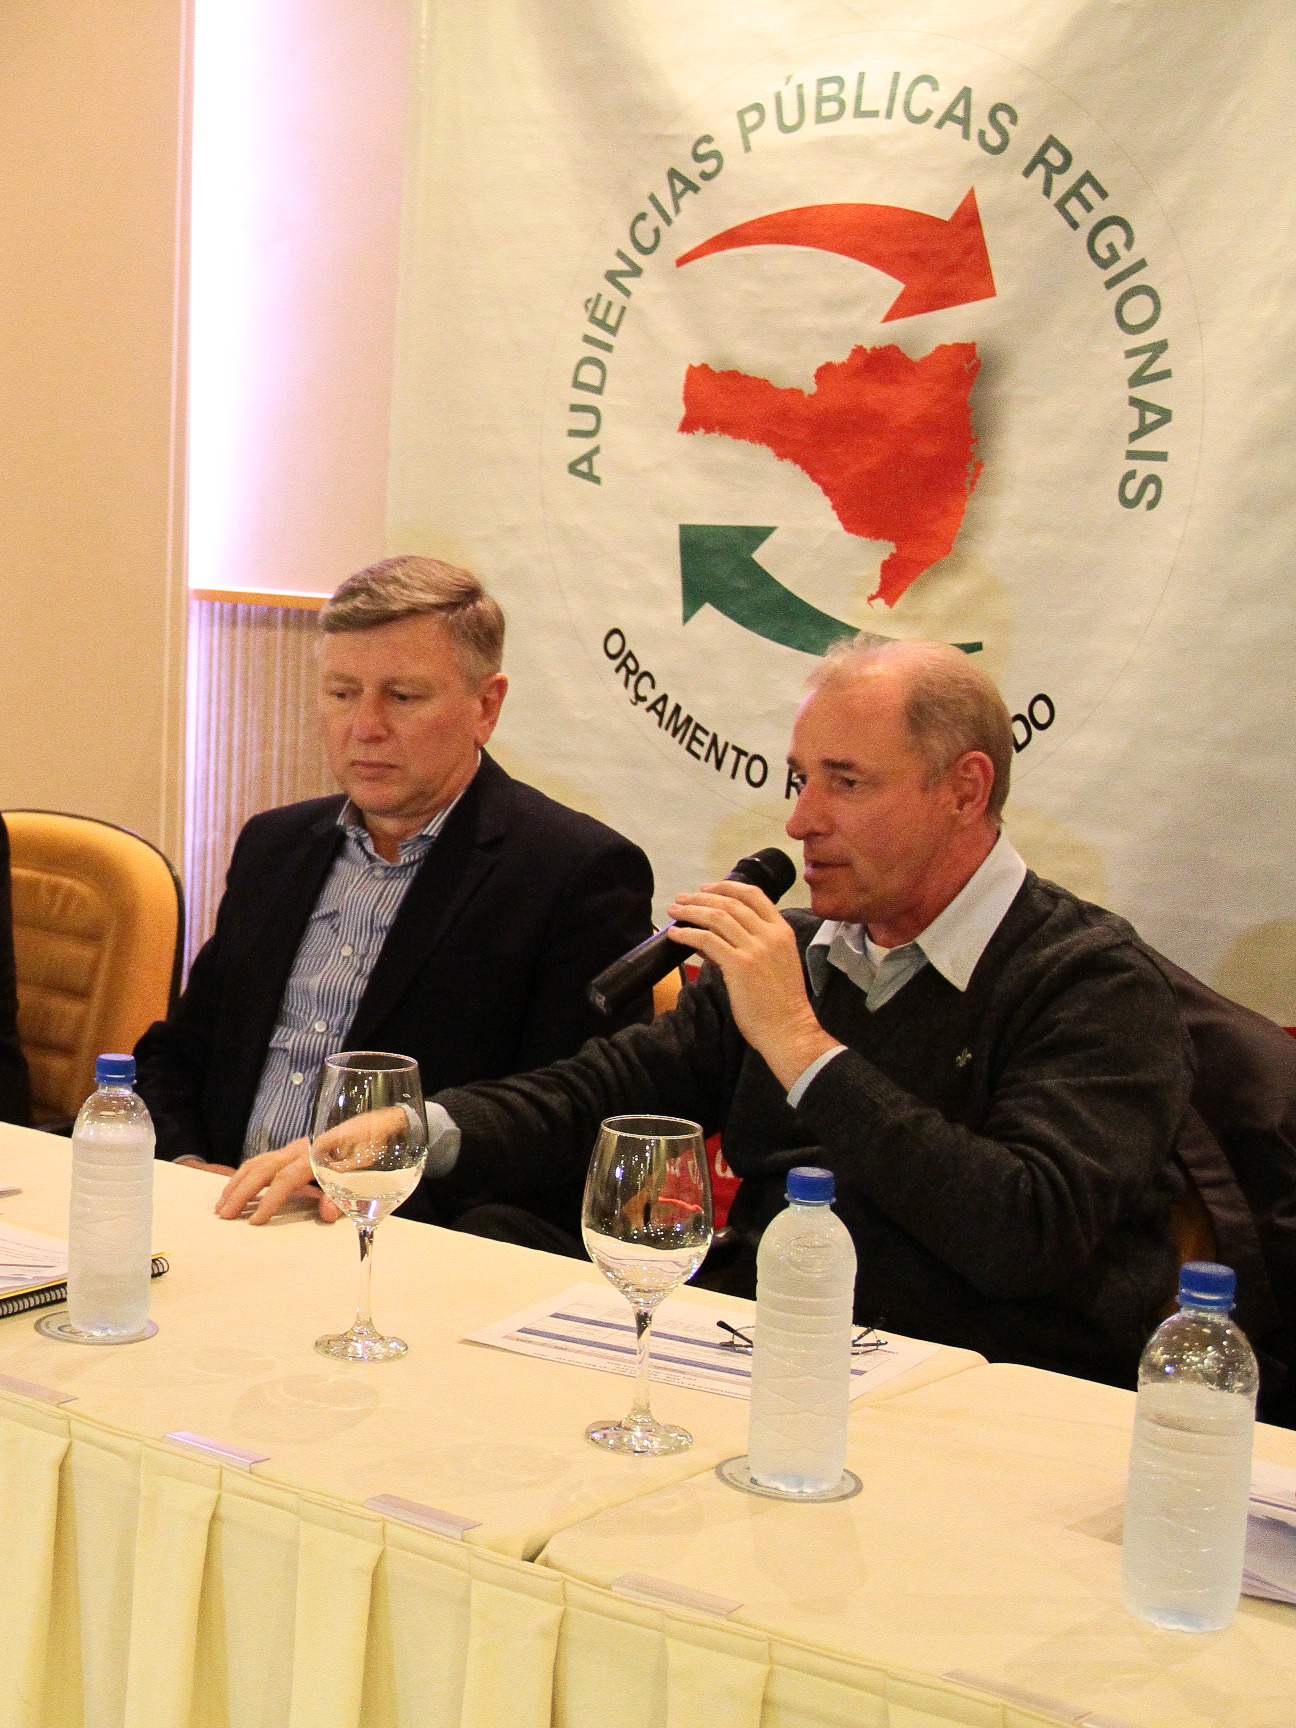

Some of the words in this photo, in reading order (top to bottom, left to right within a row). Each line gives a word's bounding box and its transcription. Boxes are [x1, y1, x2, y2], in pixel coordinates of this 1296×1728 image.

[567, 134, 724, 486] AUDIÊNCIAS
[736, 71, 1019, 156] PÚBLICAS
[1022, 134, 1173, 512] REGIONAIS
[603, 627, 769, 789] ORÇAMENTO
